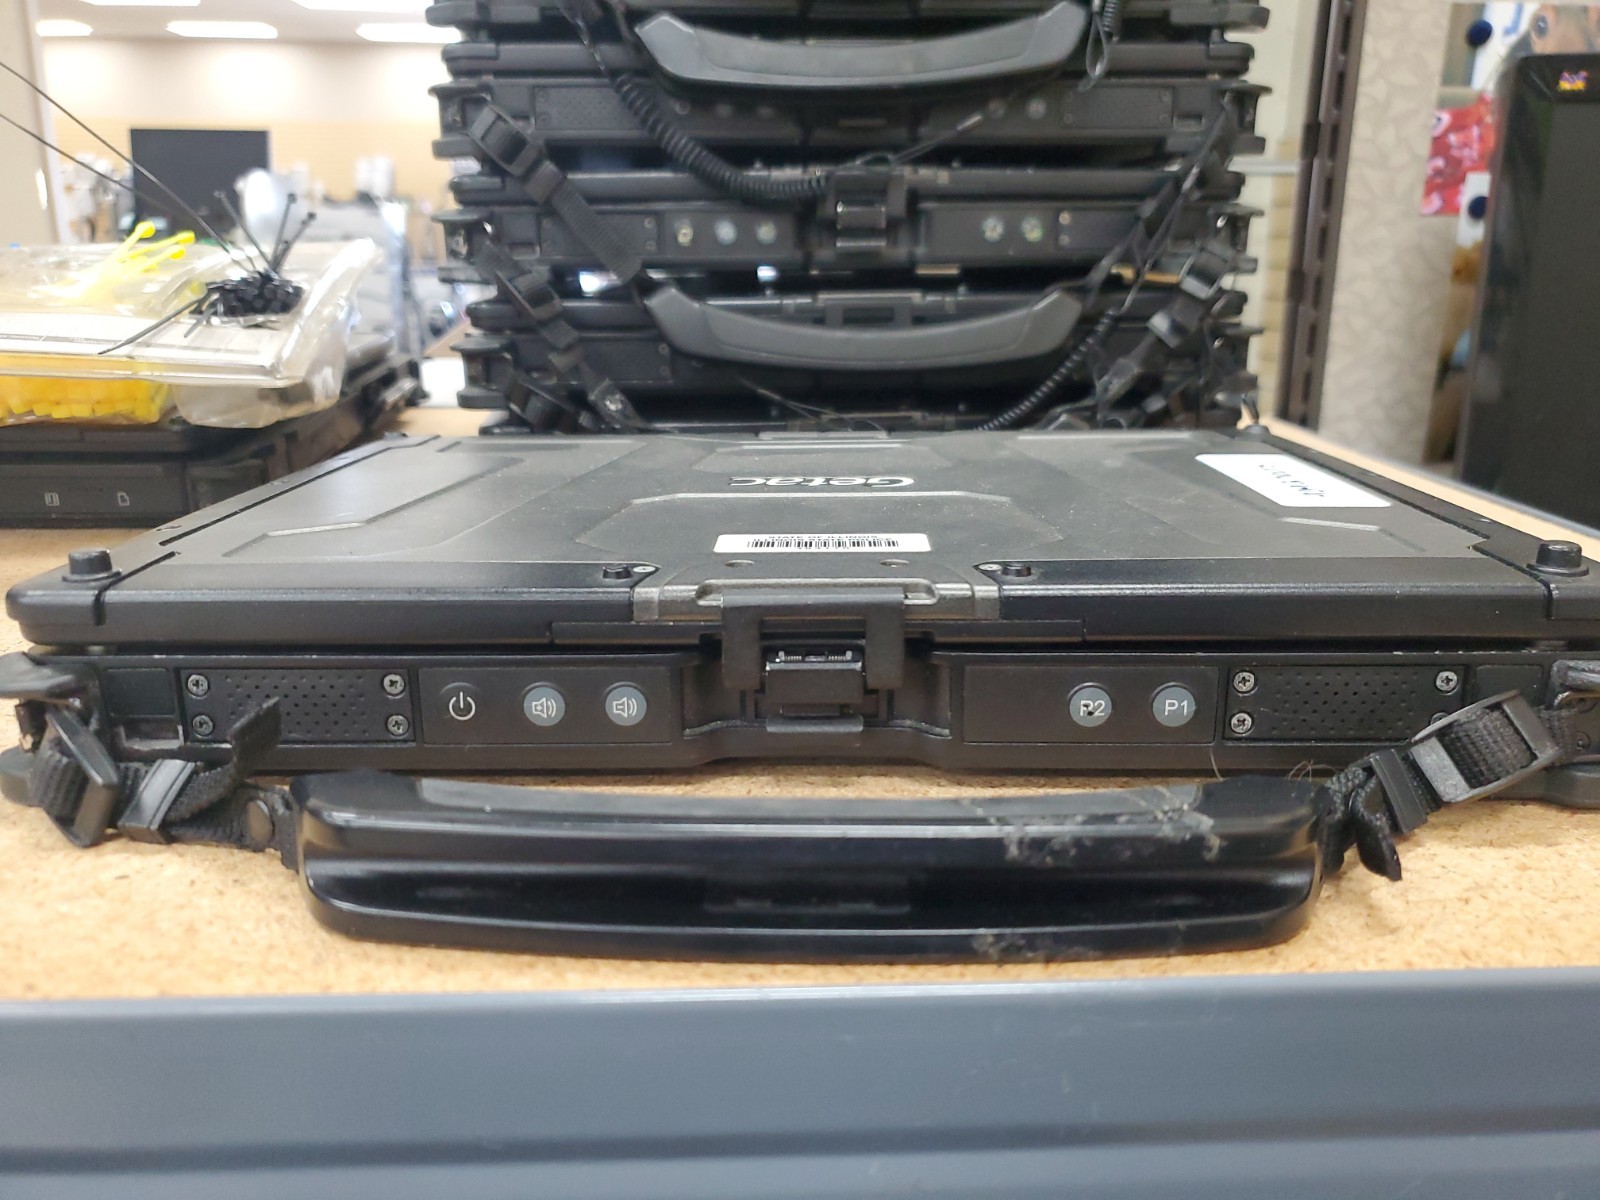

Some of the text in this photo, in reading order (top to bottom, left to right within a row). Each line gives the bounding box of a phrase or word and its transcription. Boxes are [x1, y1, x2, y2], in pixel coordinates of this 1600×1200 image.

[730, 476, 915, 488] Getac
[1079, 699, 1106, 717] P2
[1164, 699, 1189, 716] P1
